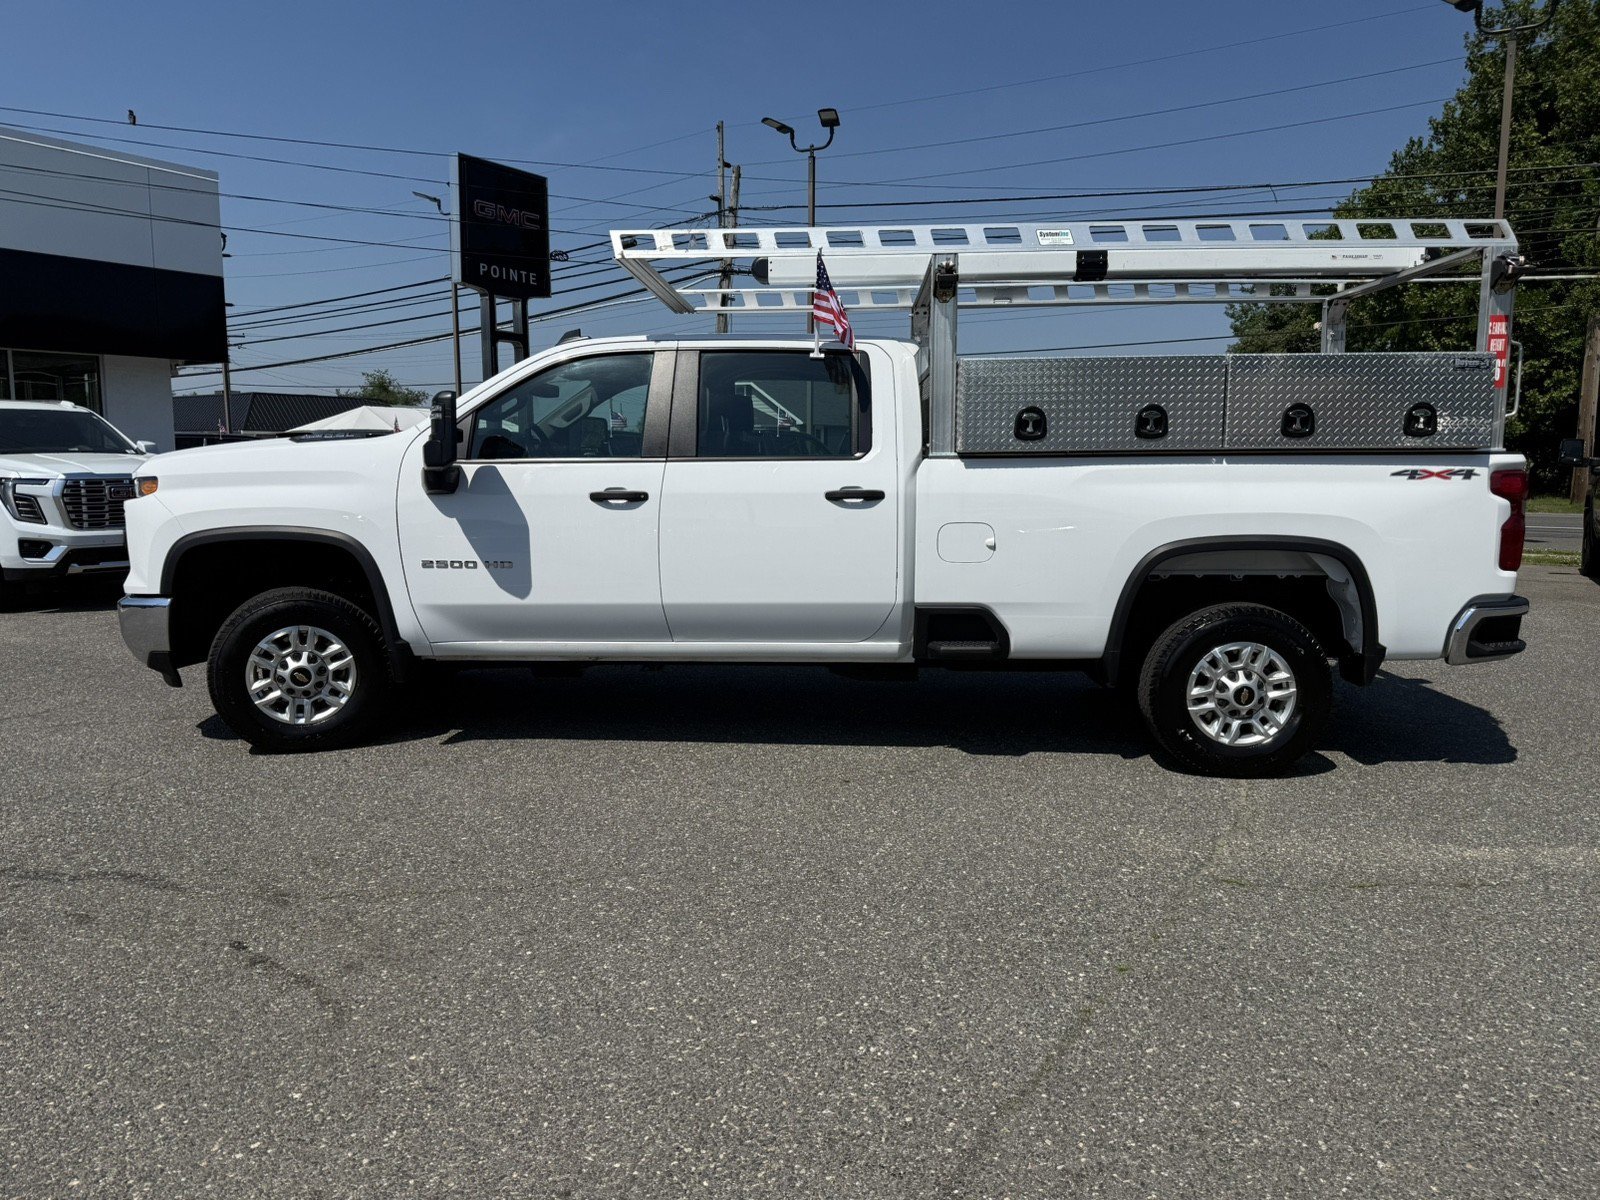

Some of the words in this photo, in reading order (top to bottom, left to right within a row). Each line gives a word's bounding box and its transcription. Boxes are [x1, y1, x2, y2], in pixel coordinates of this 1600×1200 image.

[474, 199, 540, 230] GMC
[480, 263, 537, 285] POINTE
[421, 560, 478, 569] 2500
[484, 560, 513, 569] HD
